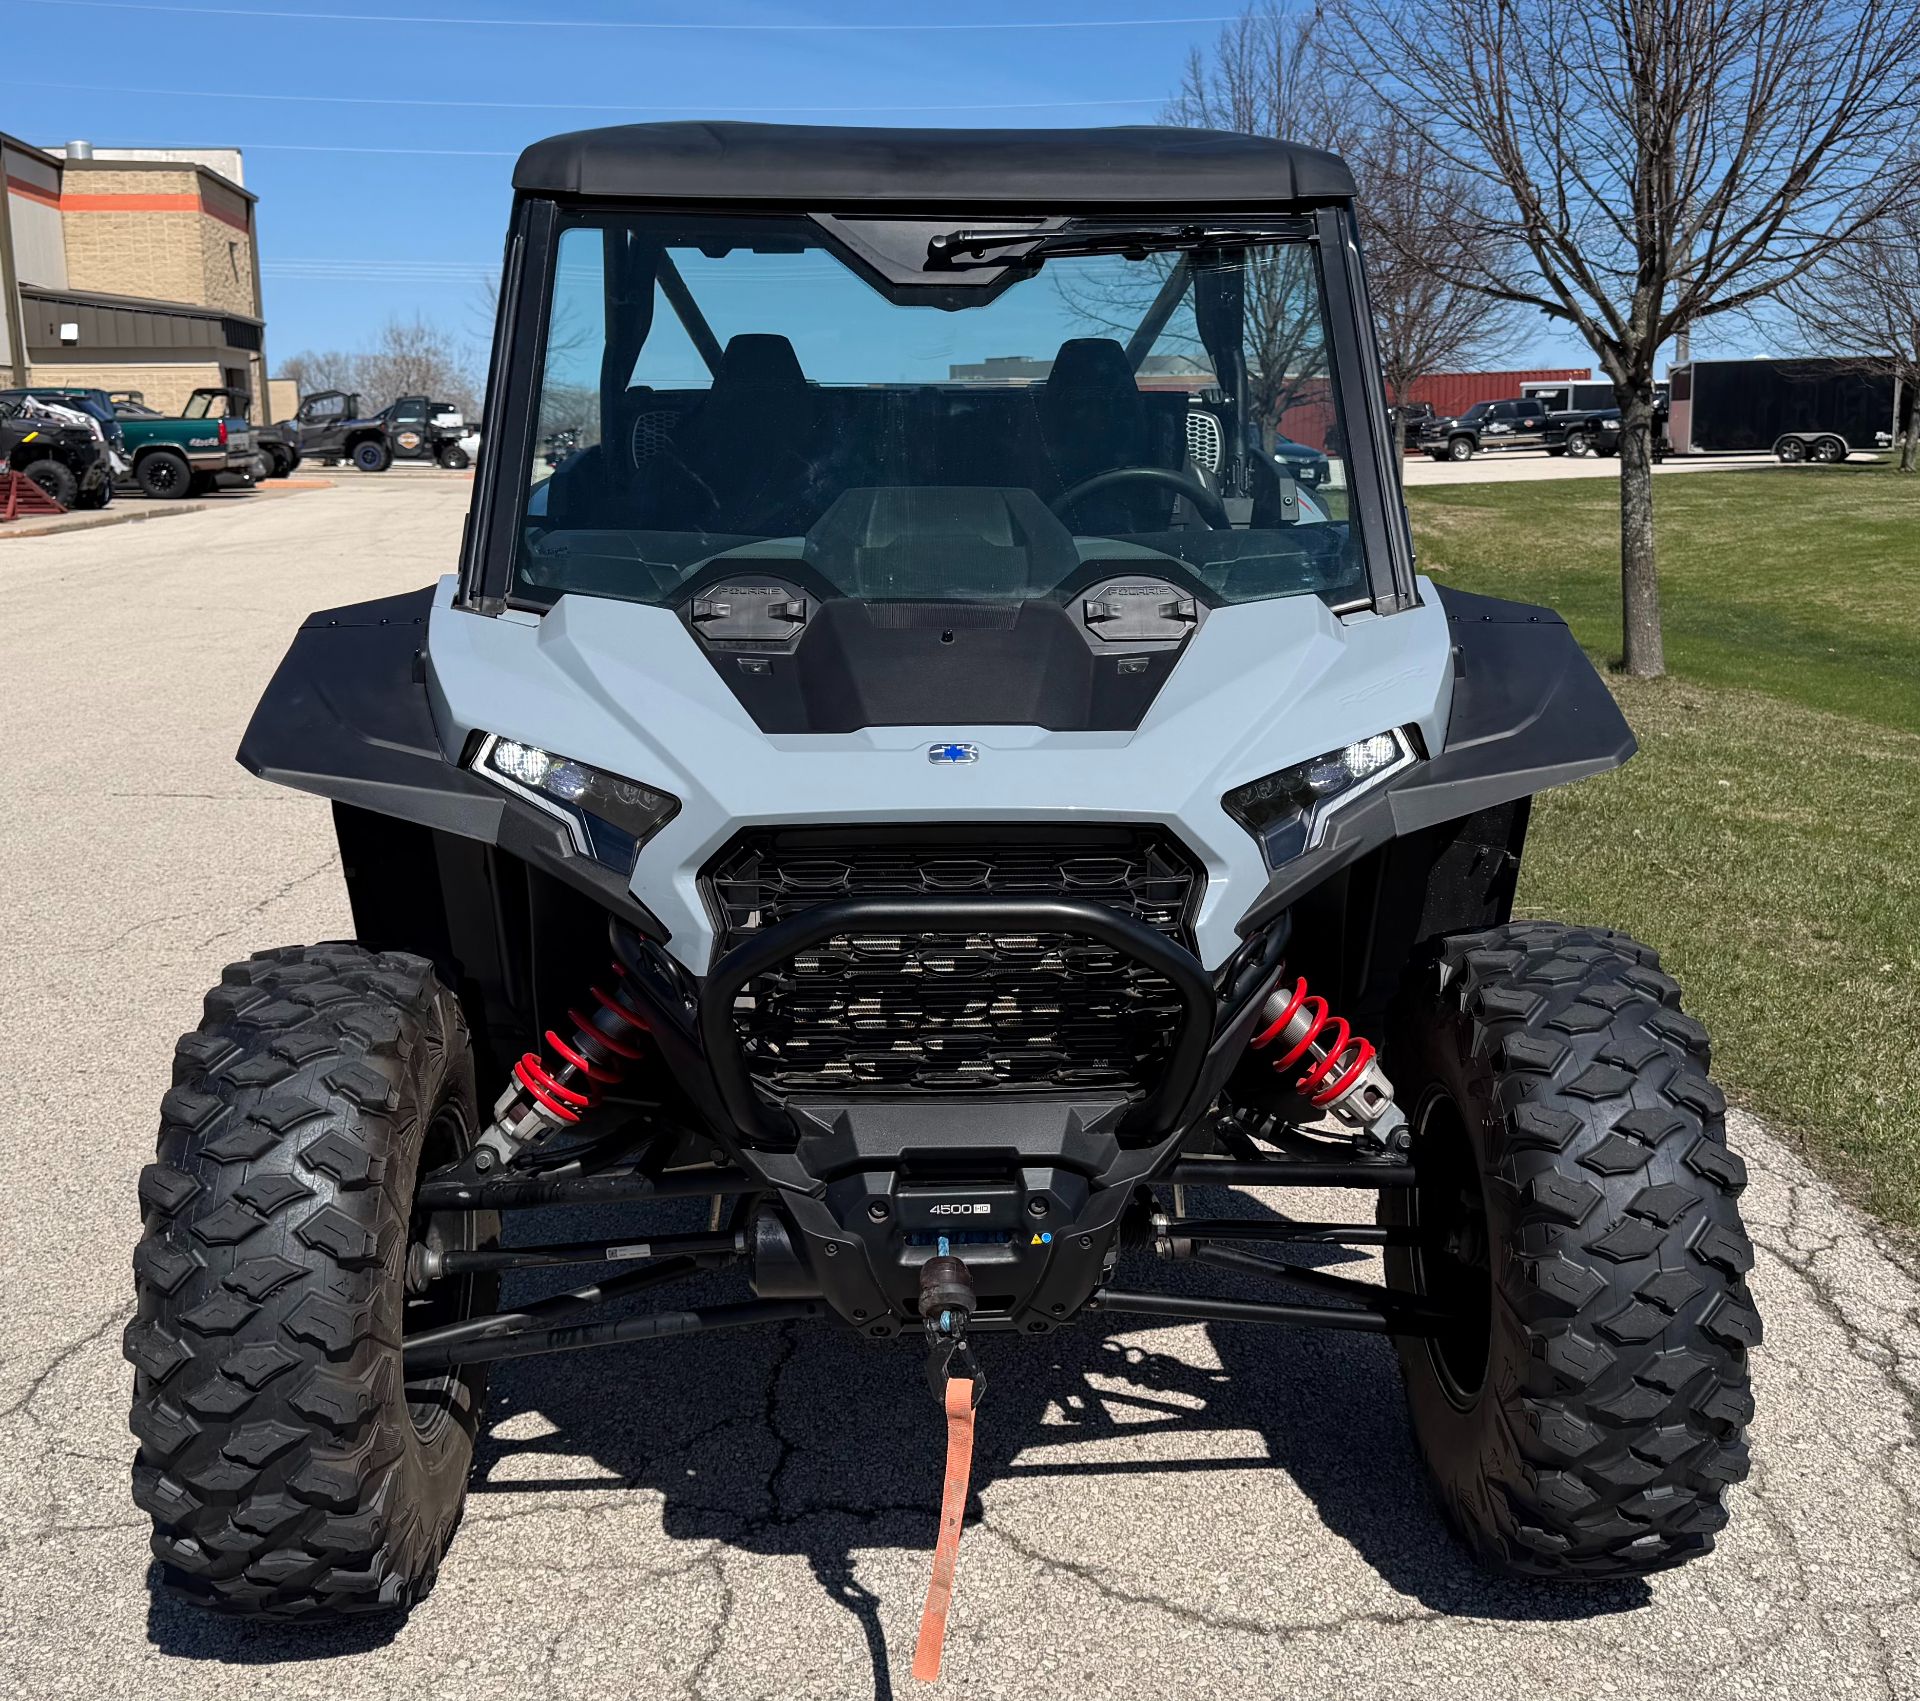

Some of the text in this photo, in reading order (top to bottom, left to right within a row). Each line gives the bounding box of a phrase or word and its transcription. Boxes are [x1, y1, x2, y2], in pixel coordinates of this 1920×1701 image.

[719, 586, 781, 595] POLARIS
[1108, 587, 1170, 596] POLARIS
[929, 1204, 991, 1214] 4500 HD
